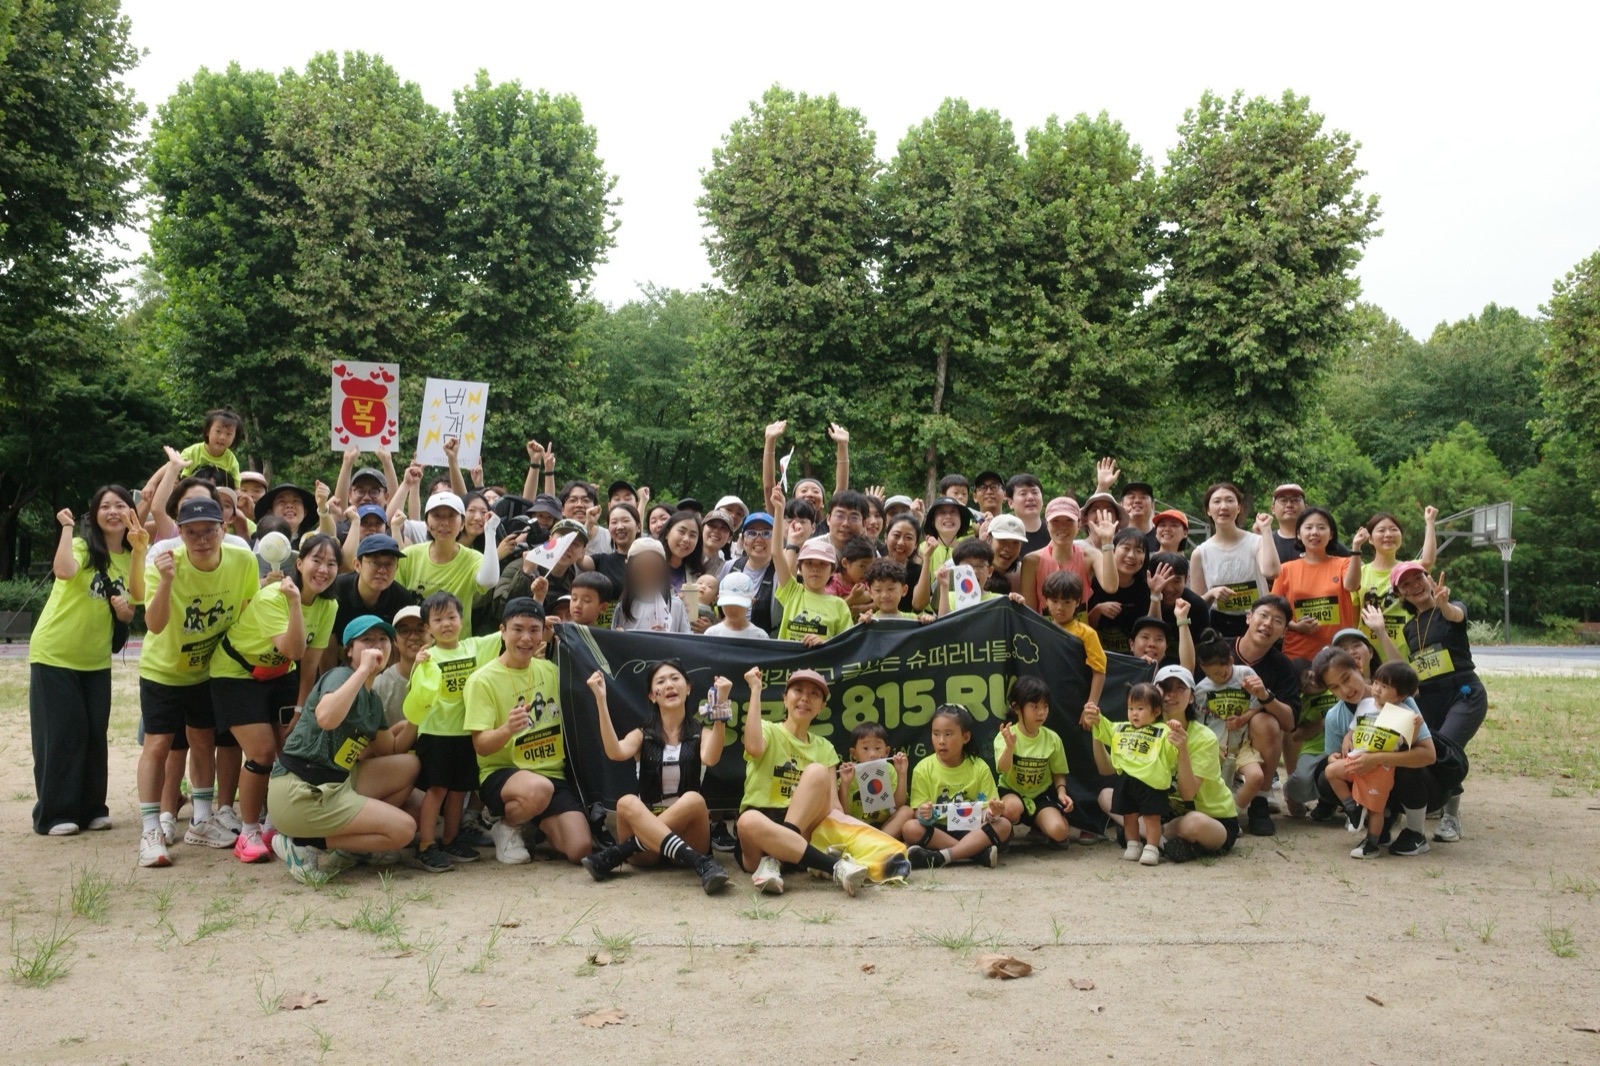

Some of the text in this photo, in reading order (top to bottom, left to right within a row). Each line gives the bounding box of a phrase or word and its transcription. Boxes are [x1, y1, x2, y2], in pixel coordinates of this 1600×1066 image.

[352, 399, 376, 434] 복
[1369, 629, 1397, 640] 김라
[906, 639, 1007, 670] 슈퍼러너들
[841, 678, 936, 733] 815
[1117, 738, 1151, 755] 우찬솔
[1356, 732, 1387, 750] 김이겸
[523, 743, 557, 761] 이대권
